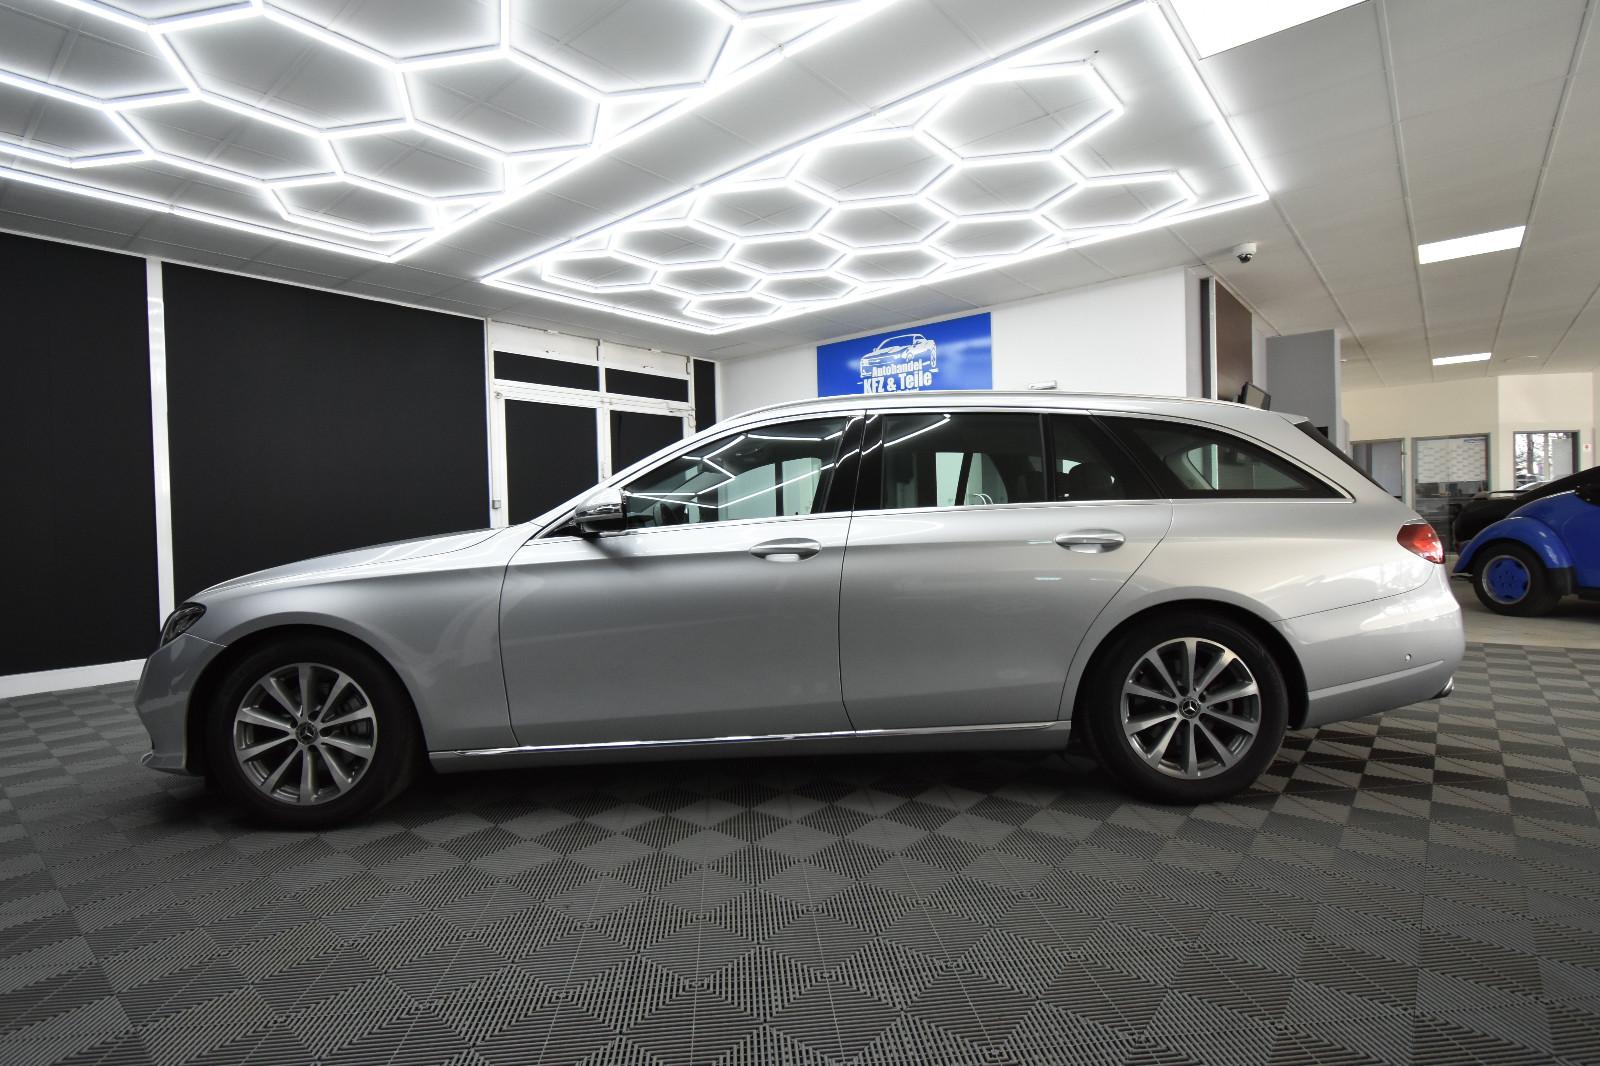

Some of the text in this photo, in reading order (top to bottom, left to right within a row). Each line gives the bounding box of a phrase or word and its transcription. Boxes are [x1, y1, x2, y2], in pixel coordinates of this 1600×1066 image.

[872, 359, 923, 377] Autohandel
[864, 371, 932, 394] KFZ & Teile
